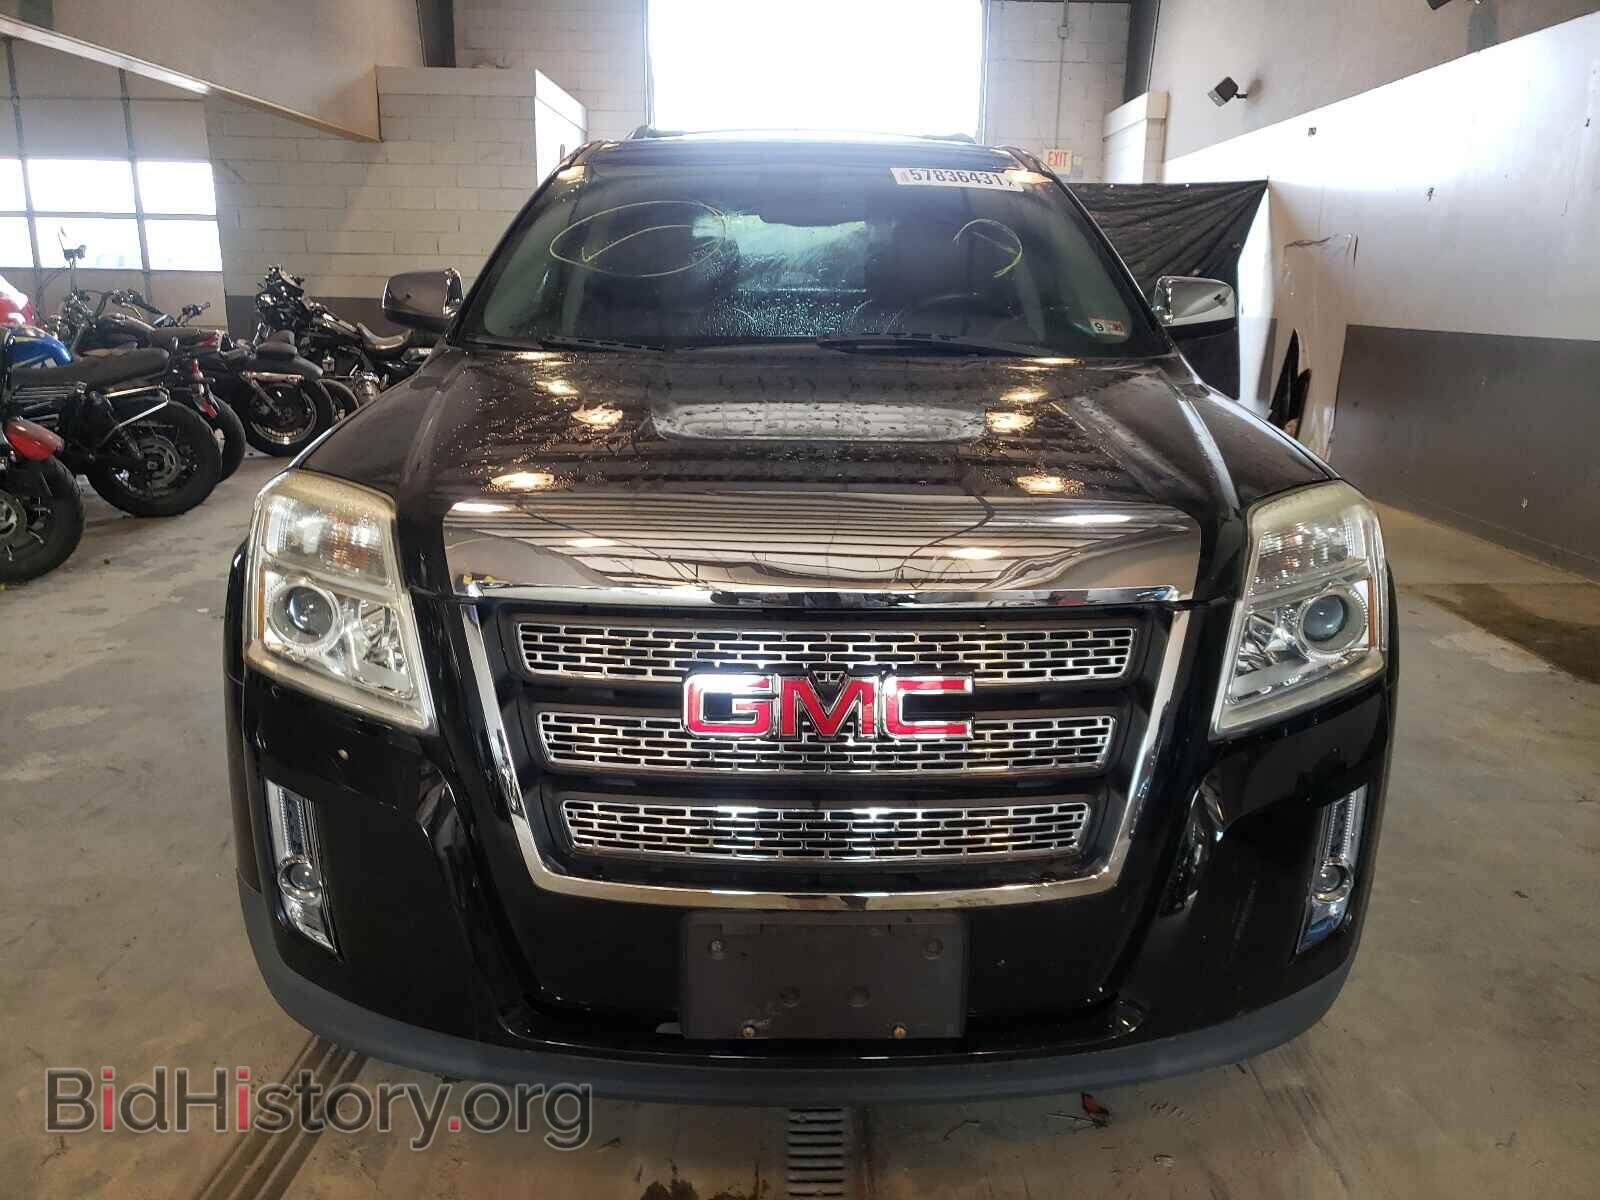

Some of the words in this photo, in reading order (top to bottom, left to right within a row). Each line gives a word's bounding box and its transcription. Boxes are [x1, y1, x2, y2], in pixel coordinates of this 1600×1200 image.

[1048, 151, 1070, 168] EXIT
[909, 169, 1003, 186] 57836431
[681, 673, 974, 740] GMC
